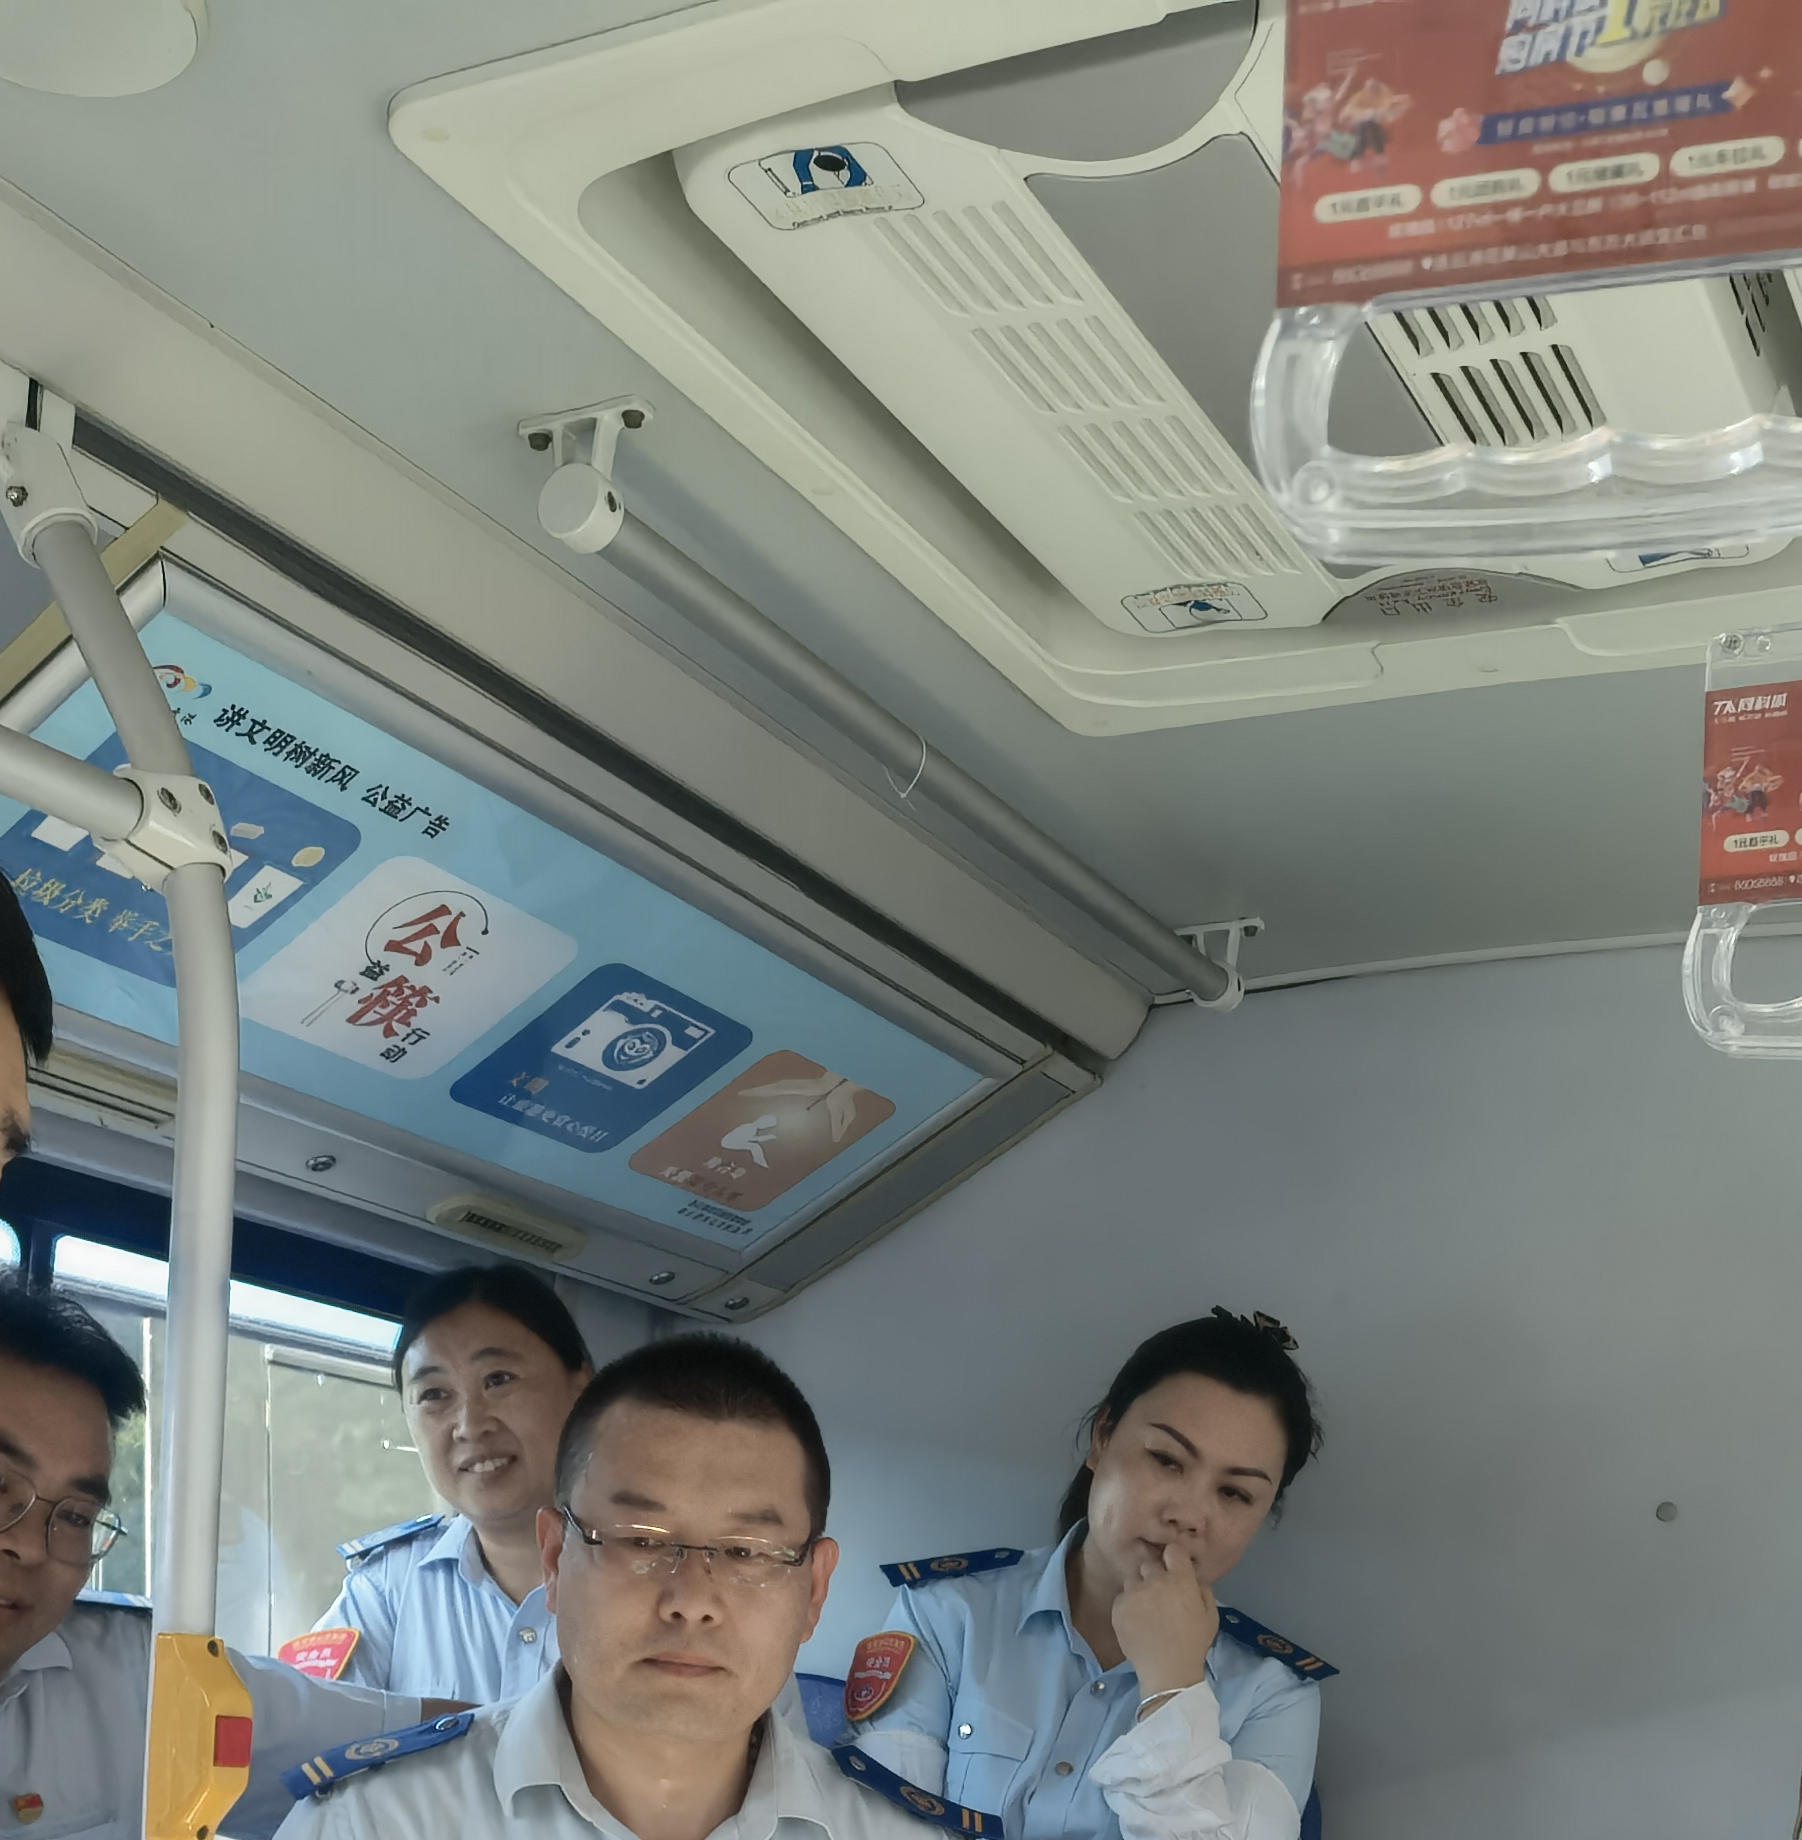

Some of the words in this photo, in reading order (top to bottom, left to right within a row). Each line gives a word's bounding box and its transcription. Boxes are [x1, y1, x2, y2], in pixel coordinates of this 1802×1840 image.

[213, 704, 360, 792] 讲文明树新风
[361, 783, 451, 839] 公益广告
